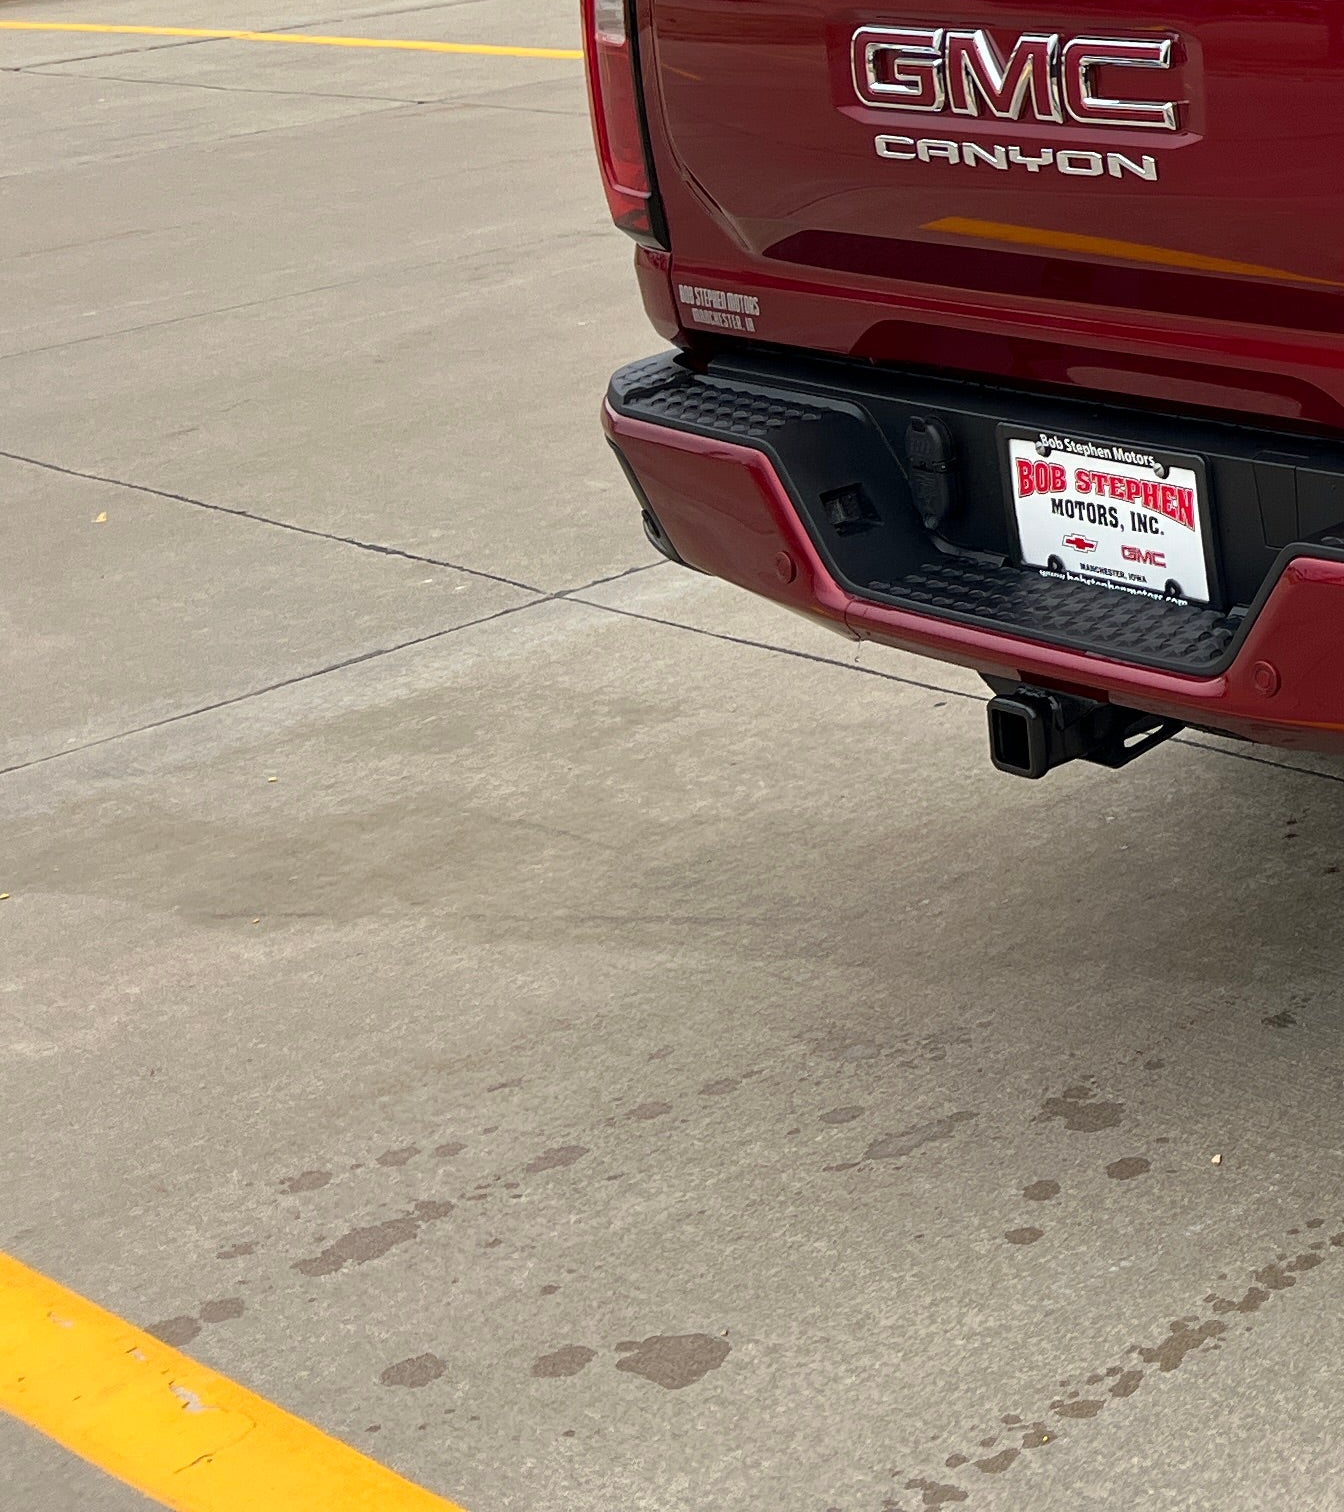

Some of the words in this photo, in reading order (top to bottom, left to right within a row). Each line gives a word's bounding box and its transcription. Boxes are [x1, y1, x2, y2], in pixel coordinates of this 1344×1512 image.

[851, 25, 1177, 131] GMC
[874, 134, 1159, 181] CANYON
[1039, 434, 1063, 450] Bob
[1064, 439, 1112, 459] Stephen
[1113, 447, 1156, 466] Motors
[1016, 457, 1067, 498] BOB
[1074, 468, 1195, 531] STEPHEN
[1051, 498, 1125, 532] MOTORS,
[1130, 510, 1165, 535] INC.
[1121, 545, 1167, 568] GMC
[1039, 569, 1188, 607] wwwbobstephenmotorscom
[1127, 571, 1147, 584] IOWA
